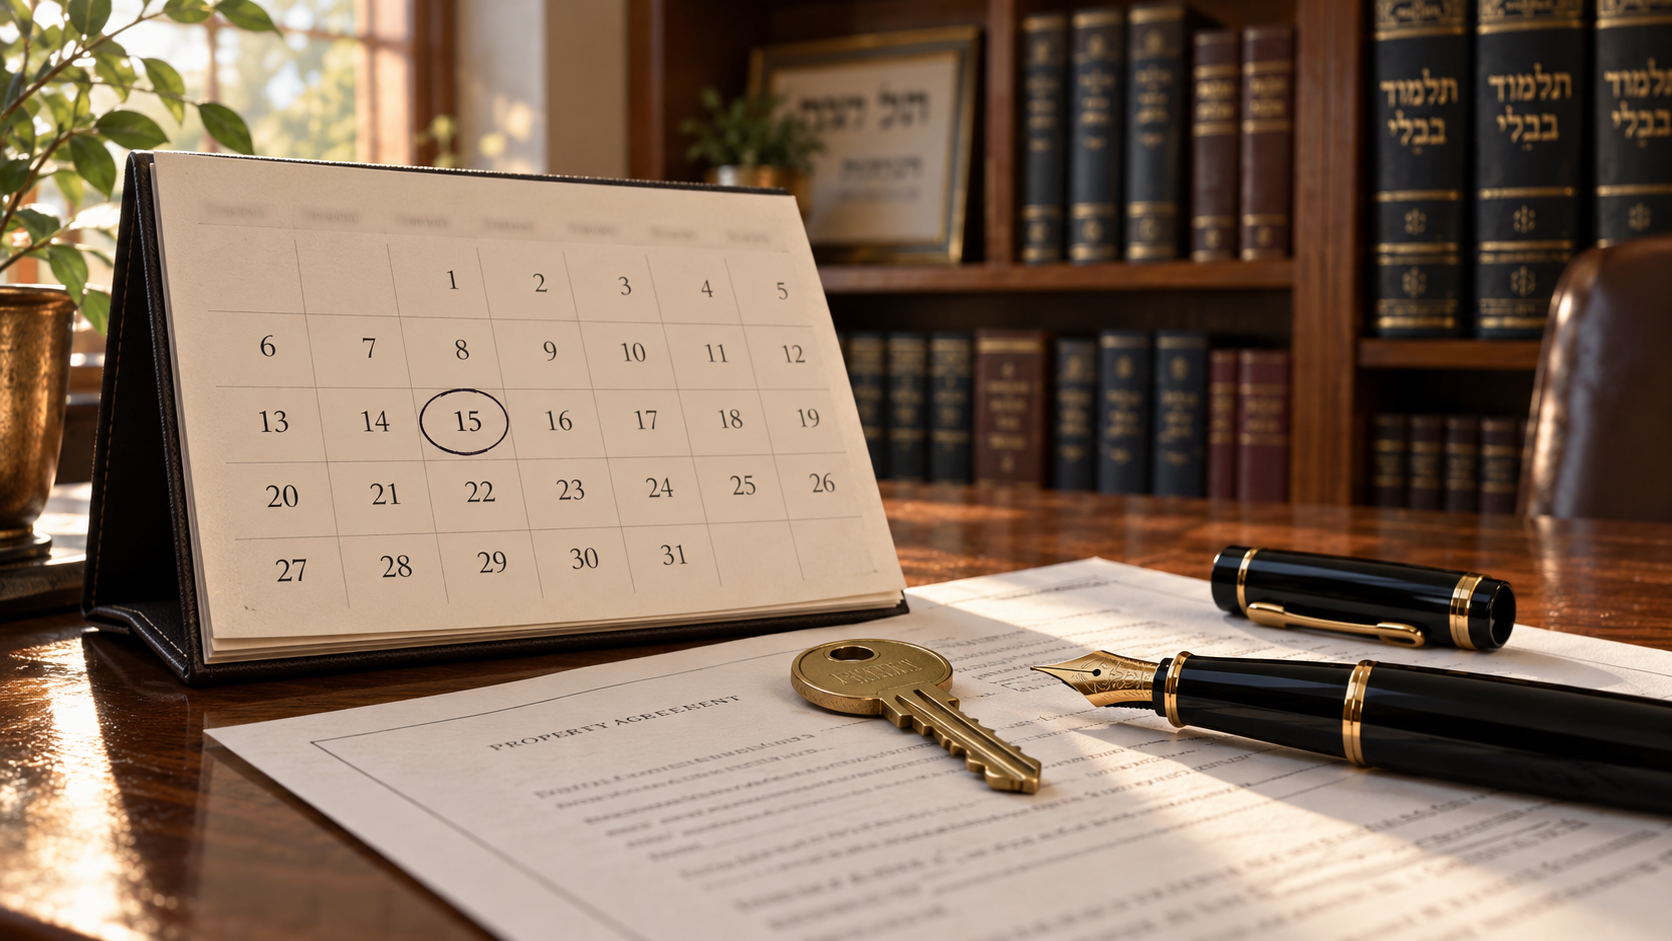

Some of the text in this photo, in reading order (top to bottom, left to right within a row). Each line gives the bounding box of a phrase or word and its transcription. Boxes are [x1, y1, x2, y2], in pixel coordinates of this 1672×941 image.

[1379, 67, 1458, 107] תלמוד
[1487, 62, 1572, 103] תלמוד
[1387, 109, 1447, 154] בבלי
[1496, 104, 1559, 152] בבלי
[1611, 99, 1672, 148] בבלי
[446, 269, 789, 299] 1 2 3 4 5
[259, 334, 806, 364] 6 7 8 9 10 11 12
[258, 408, 820, 433] 13 14 15 16 17 18 19
[265, 472, 836, 508] 20 21 22 23 24 25 26
[275, 544, 688, 583] 27 28 29 30 31
[486, 721, 609, 751] PROPERTY
